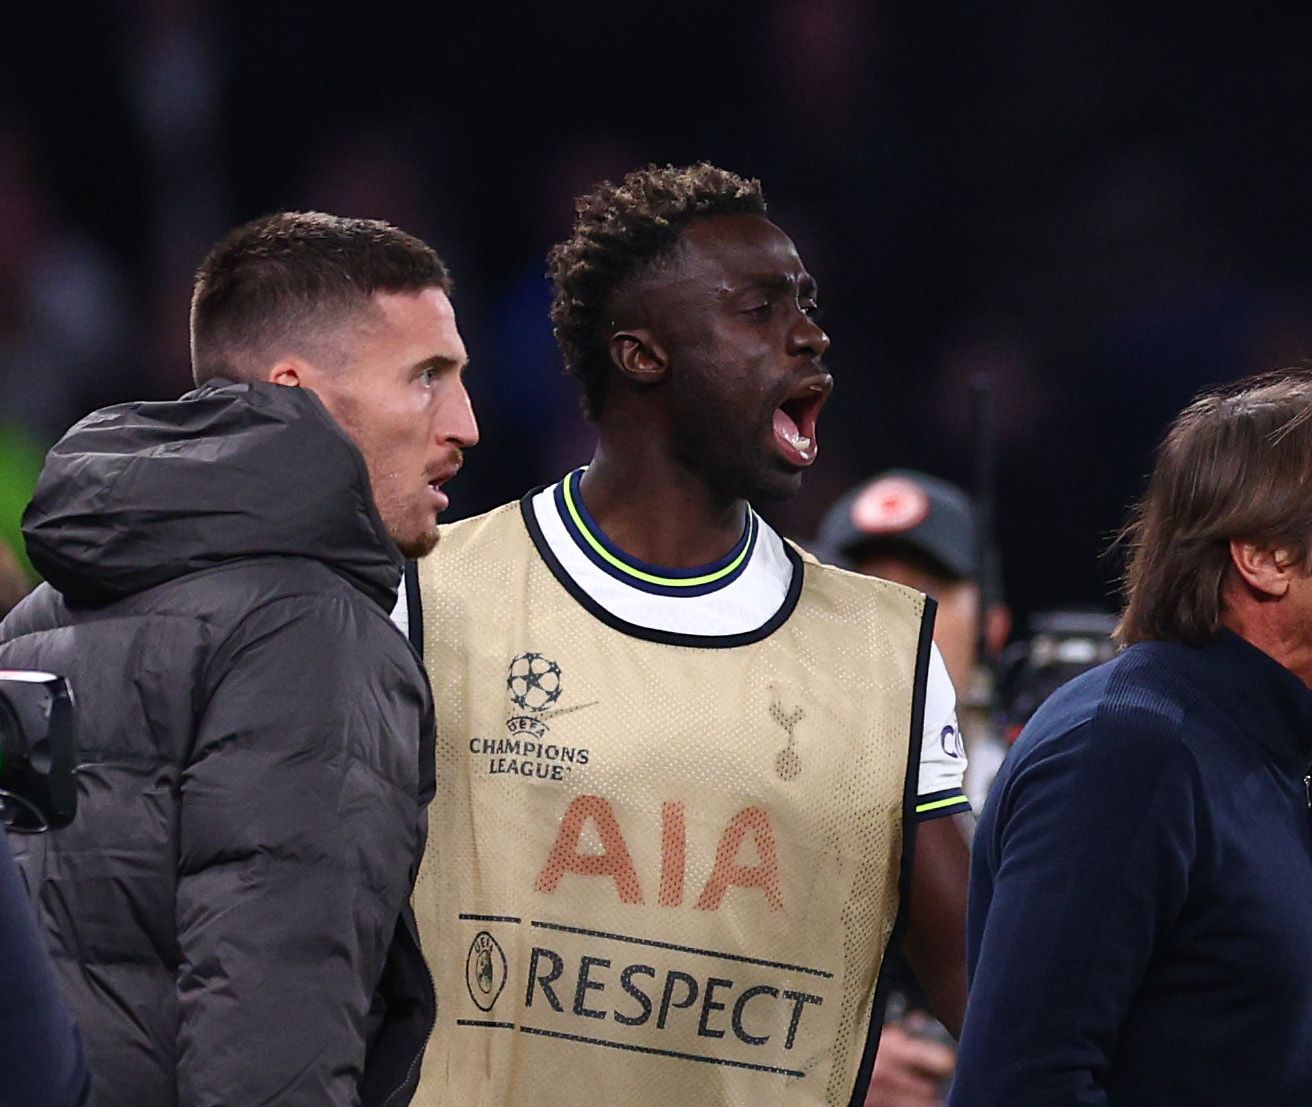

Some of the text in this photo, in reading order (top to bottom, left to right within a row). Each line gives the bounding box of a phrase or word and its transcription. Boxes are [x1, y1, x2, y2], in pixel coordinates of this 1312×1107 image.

[469, 737, 589, 765] CHAMPIONS
[489, 758, 564, 781] LEAGUE
[534, 794, 784, 912] AIA
[524, 946, 823, 1051] RESPECT
